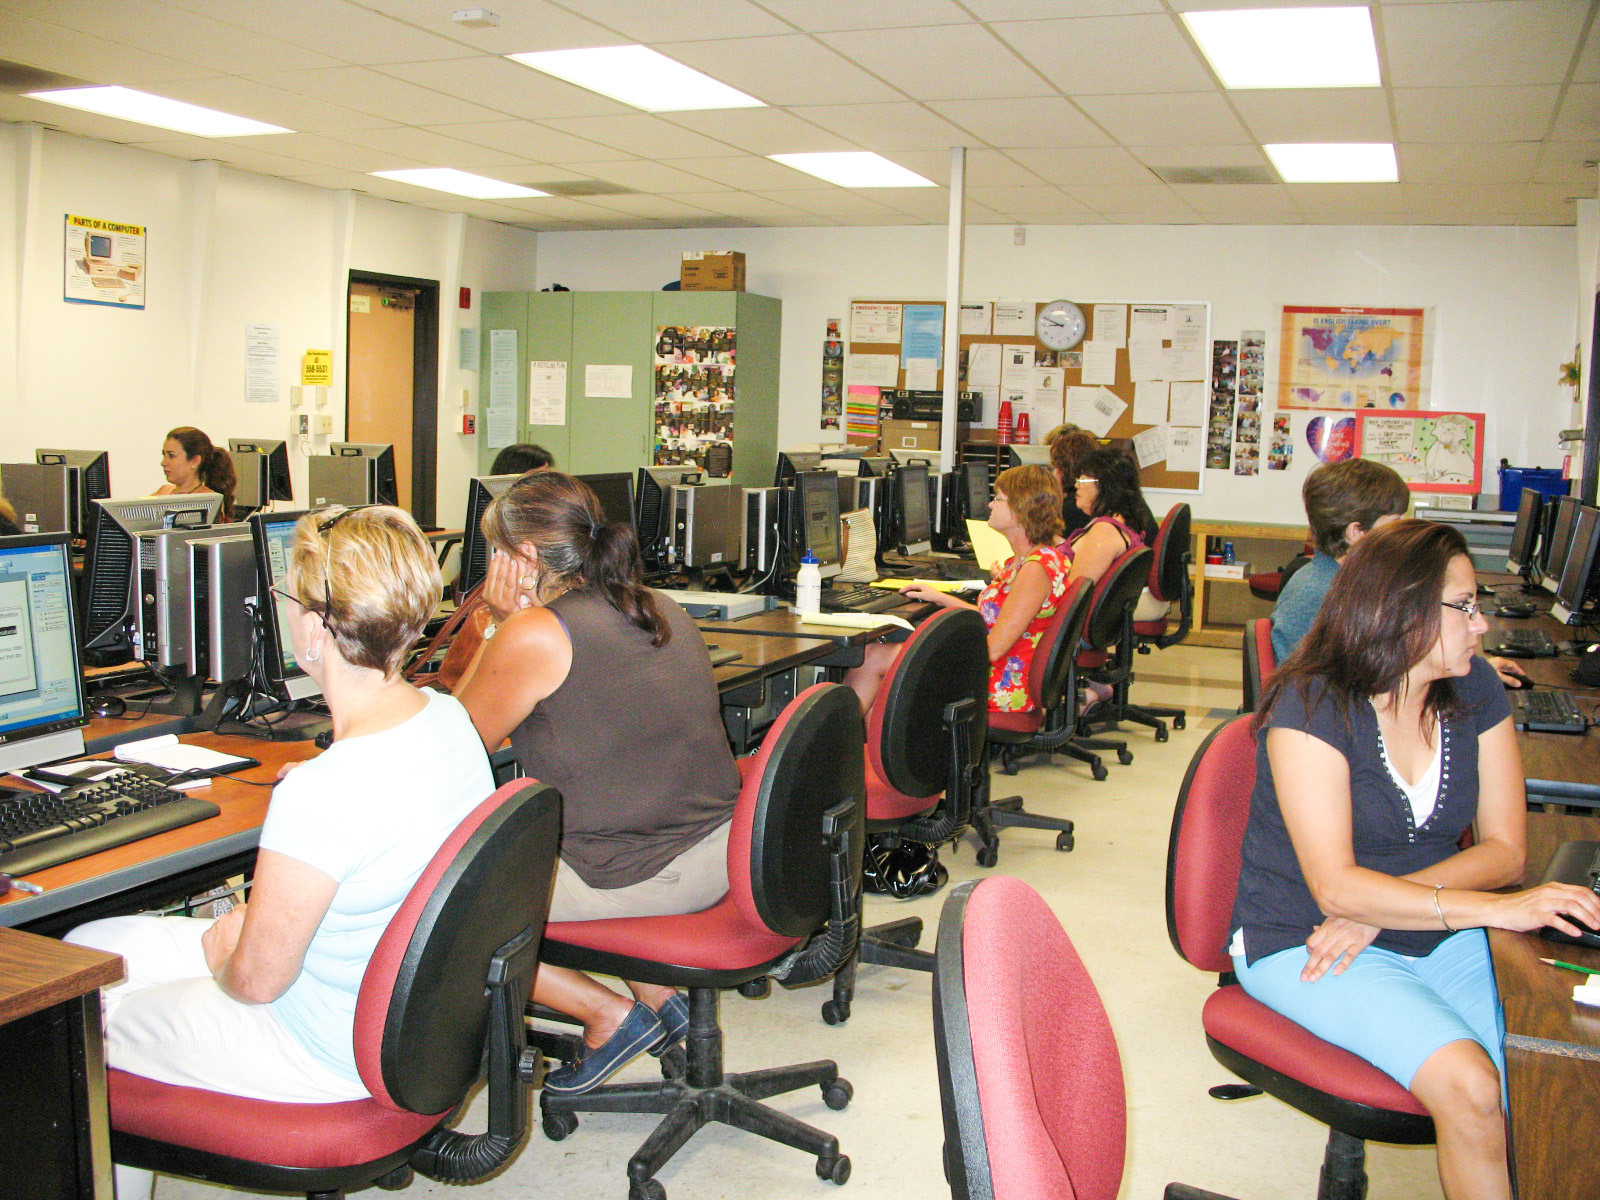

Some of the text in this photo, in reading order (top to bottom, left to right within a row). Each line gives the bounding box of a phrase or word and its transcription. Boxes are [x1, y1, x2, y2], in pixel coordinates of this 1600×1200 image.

[73, 217, 92, 227] PARTS
[93, 220, 102, 229] OF
[108, 223, 140, 235] COMPUTER
